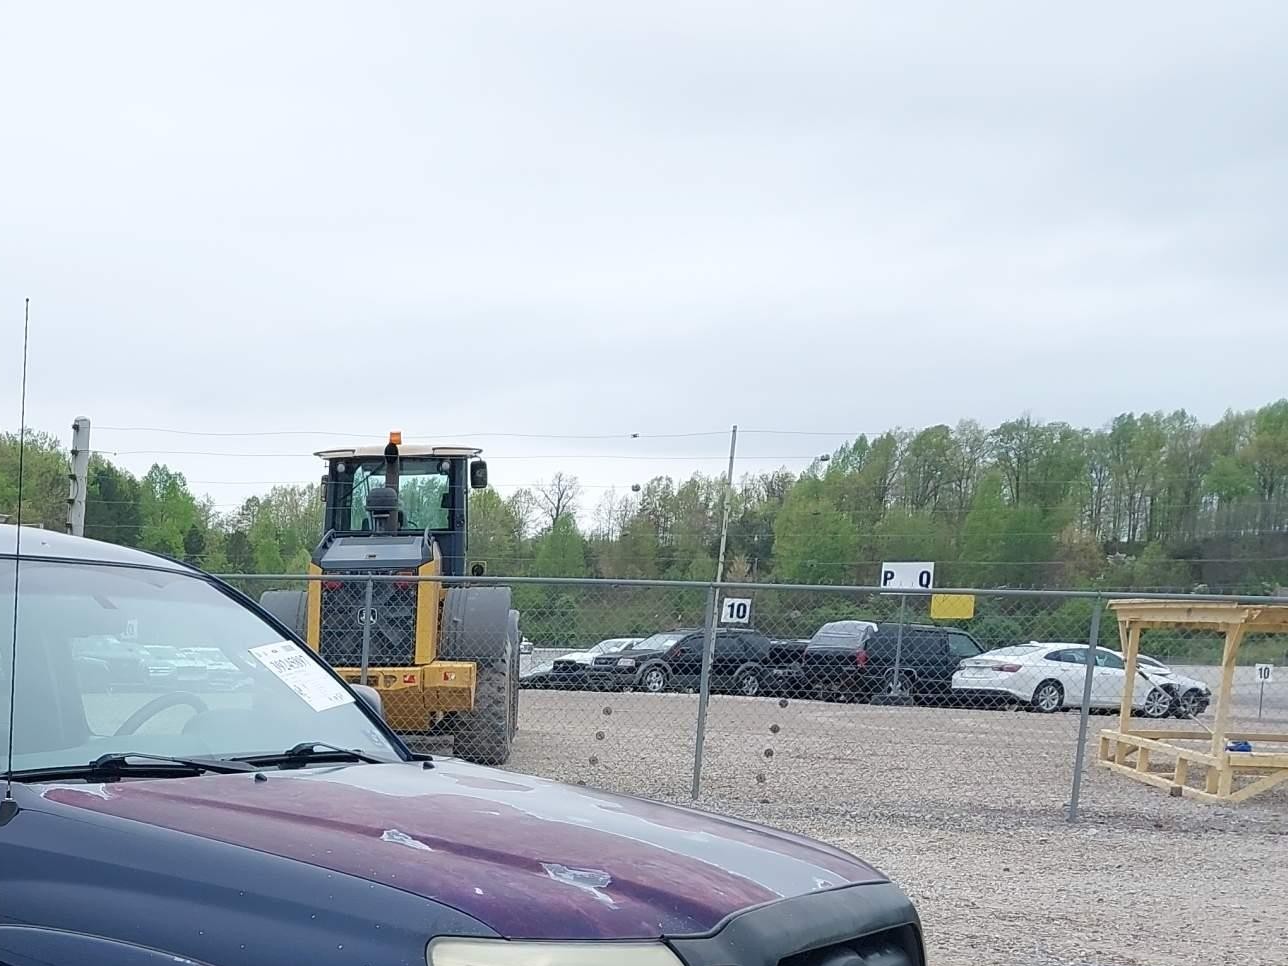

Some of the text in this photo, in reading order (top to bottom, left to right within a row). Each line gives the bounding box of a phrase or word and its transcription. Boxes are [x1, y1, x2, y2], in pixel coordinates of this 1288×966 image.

[882, 570, 931, 589] P Q
[727, 602, 748, 619] 10
[1258, 667, 1270, 680] 10
